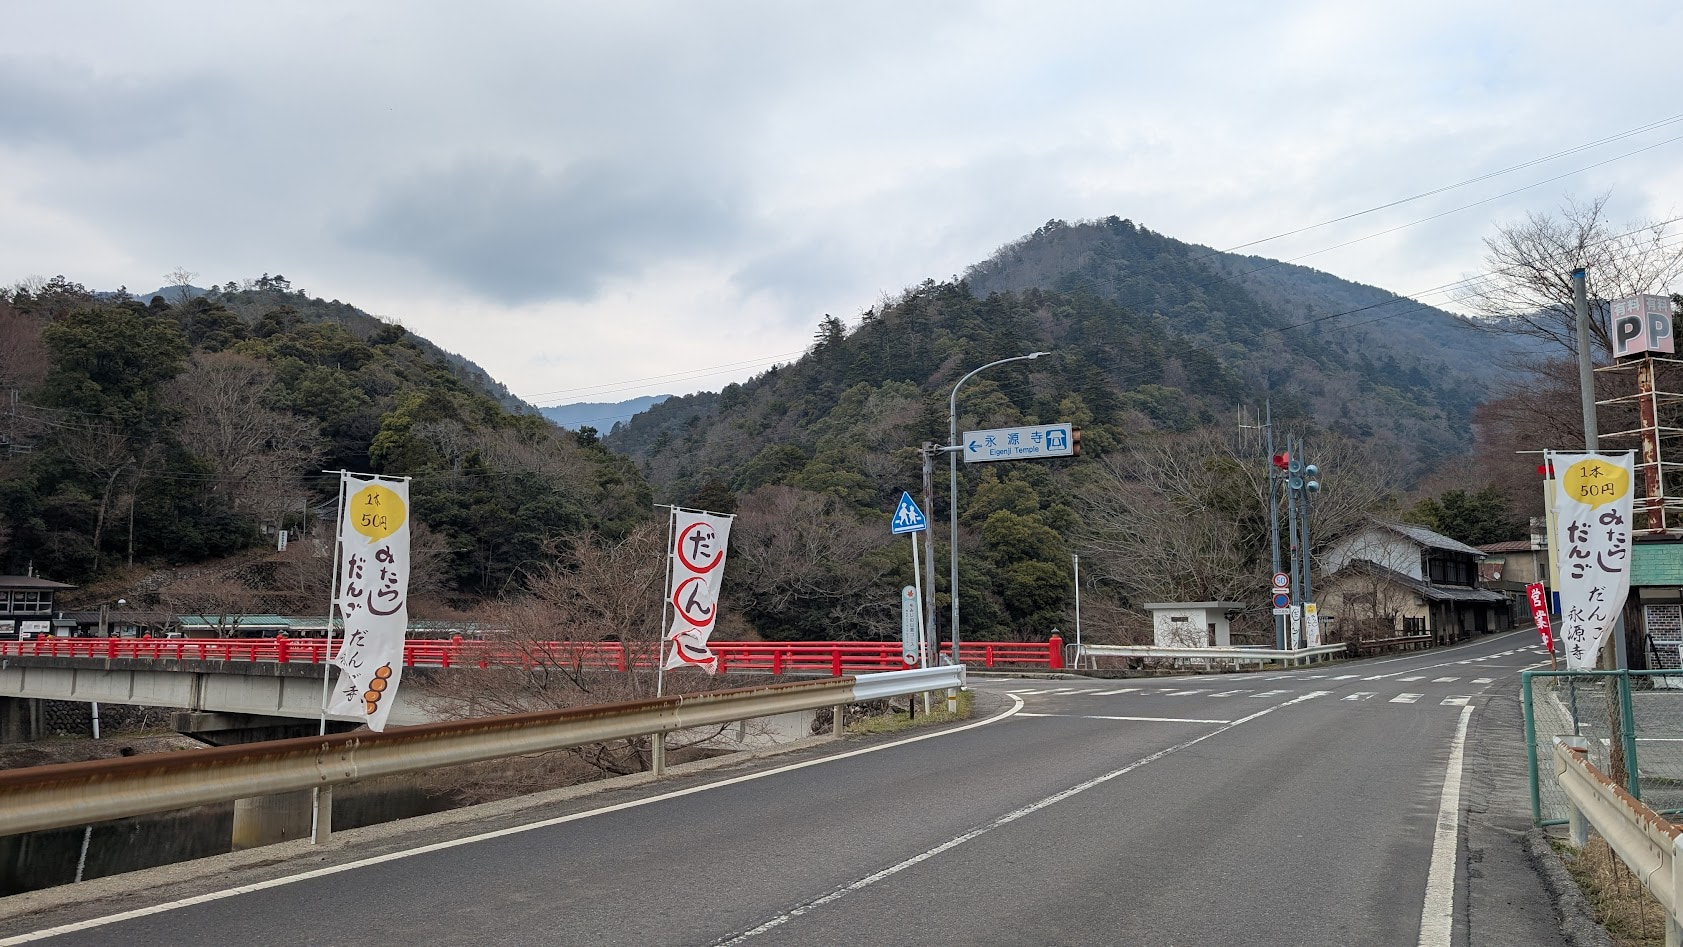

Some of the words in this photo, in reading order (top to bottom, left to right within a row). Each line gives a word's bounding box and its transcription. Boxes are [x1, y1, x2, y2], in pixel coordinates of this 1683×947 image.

[1613, 298, 1640, 317] 有料
[1646, 297, 1668, 312] 有料
[1615, 315, 1643, 354] P
[1647, 312, 1671, 349] P
[985, 430, 1043, 447] 永源寺
[989, 447, 1012, 457] Eigenji
[1014, 445, 1040, 454] Temple
[1580, 466, 1604, 479] 1本
[1580, 482, 1615, 497] 50円
[1567, 520, 1592, 579] だんご
[1597, 508, 1626, 573] みたらし
[367, 545, 403, 616] みたらし
[1276, 576, 1286, 584] 50
[1567, 605, 1586, 661] 永源寺
